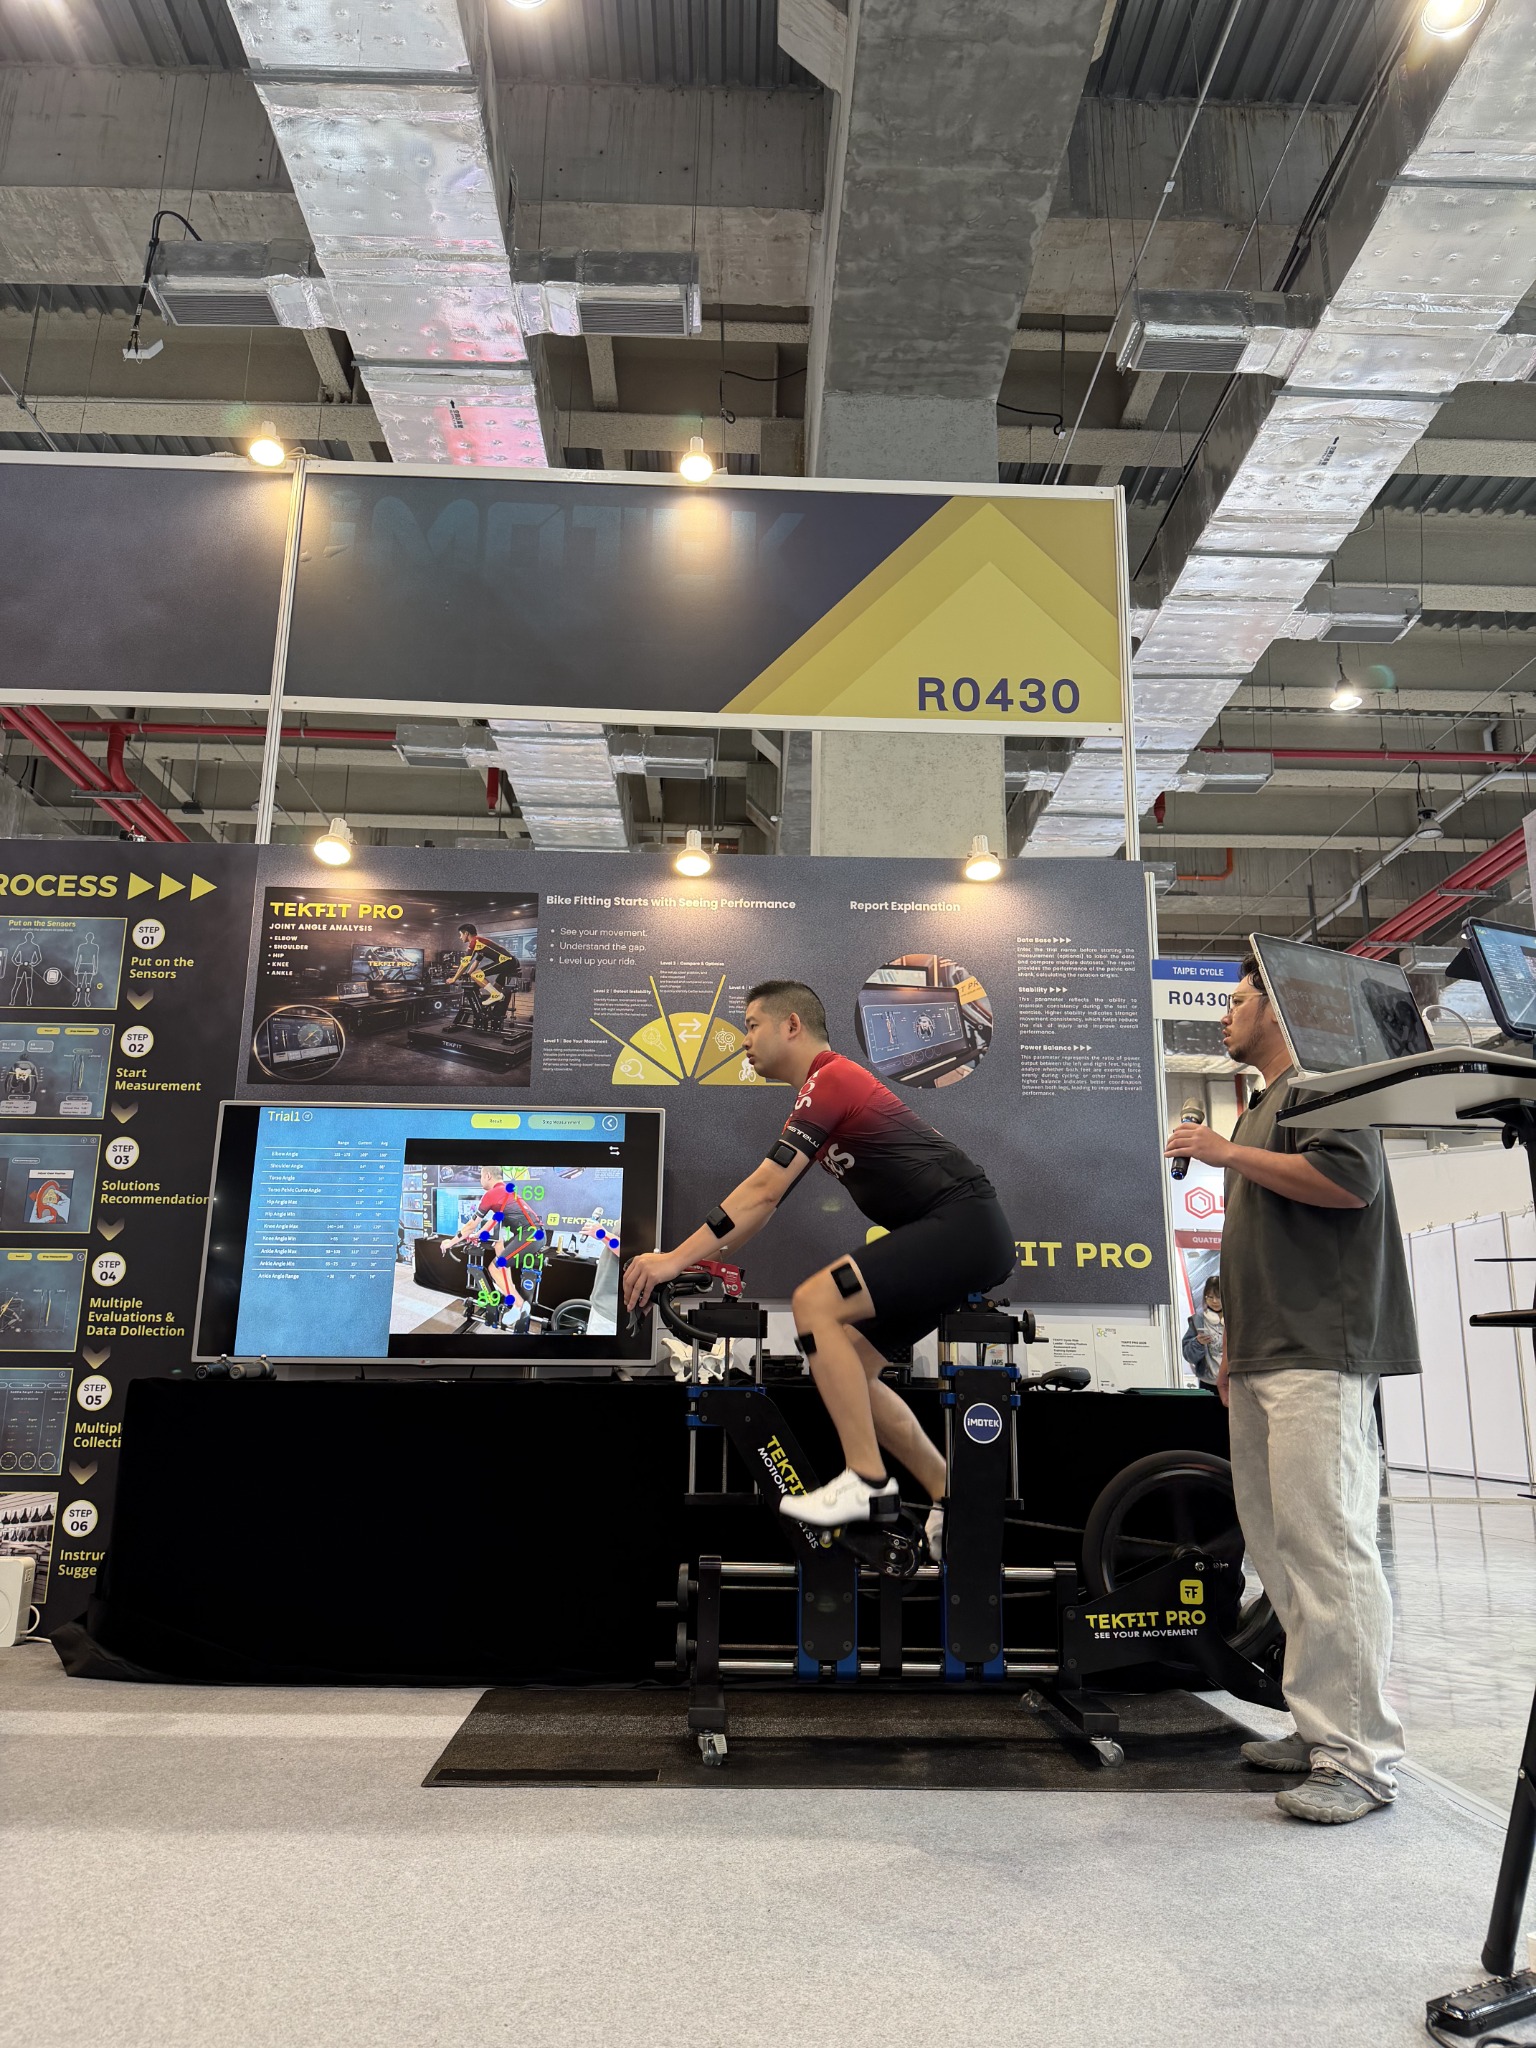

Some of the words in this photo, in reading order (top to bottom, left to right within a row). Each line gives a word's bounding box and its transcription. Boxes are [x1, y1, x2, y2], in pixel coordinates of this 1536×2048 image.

[918, 677, 1080, 713] R0430
[546, 896, 572, 905] Bike
[574, 896, 611, 908] Fitting
[614, 896, 648, 906] Starts
[651, 897, 676, 907] with
[678, 898, 718, 910] Seeing
[721, 898, 796, 909] Performance
[850, 901, 889, 913] Report
[891, 901, 961, 913] Explanation
[270, 902, 351, 918] TEKFIT
[359, 905, 403, 919] PRO
[142, 936, 154, 945] 01
[560, 942, 610, 950] Understand
[131, 957, 152, 966] Put
[174, 957, 194, 967] the
[130, 970, 176, 979] Sensors
[1200, 968, 1224, 976] CYCLE
[1169, 991, 1227, 1006] R0430
[129, 1044, 144, 1052] 02
[116, 1068, 147, 1078] Start
[115, 1081, 201, 1091] Measurement
[268, 1111, 300, 1122] Trial1
[114, 1156, 129, 1164] 03
[102, 1181, 160, 1191] Solutions
[513, 1185, 545, 1200] 169
[505, 1226, 537, 1242] 112
[1076, 1242, 1152, 1269] PRO
[514, 1253, 544, 1269] 101
[100, 1271, 116, 1281] 04
[90, 1298, 143, 1309] Multiple
[88, 1312, 162, 1322] Evaluations
[165, 1313, 175, 1322] &
[86, 1326, 116, 1336] Data
[85, 1395, 102, 1405] 05
[967, 1418, 1000, 1428] iMOTEK
[758, 1447, 788, 1494] MOTION
[70, 1521, 88, 1531] 06
[1085, 1612, 1159, 1629] TEKFIT
[1166, 1610, 1206, 1626] PRO
[1113, 1631, 1140, 1639] YOUR
[1142, 1628, 1198, 1638] MOVEMENT
